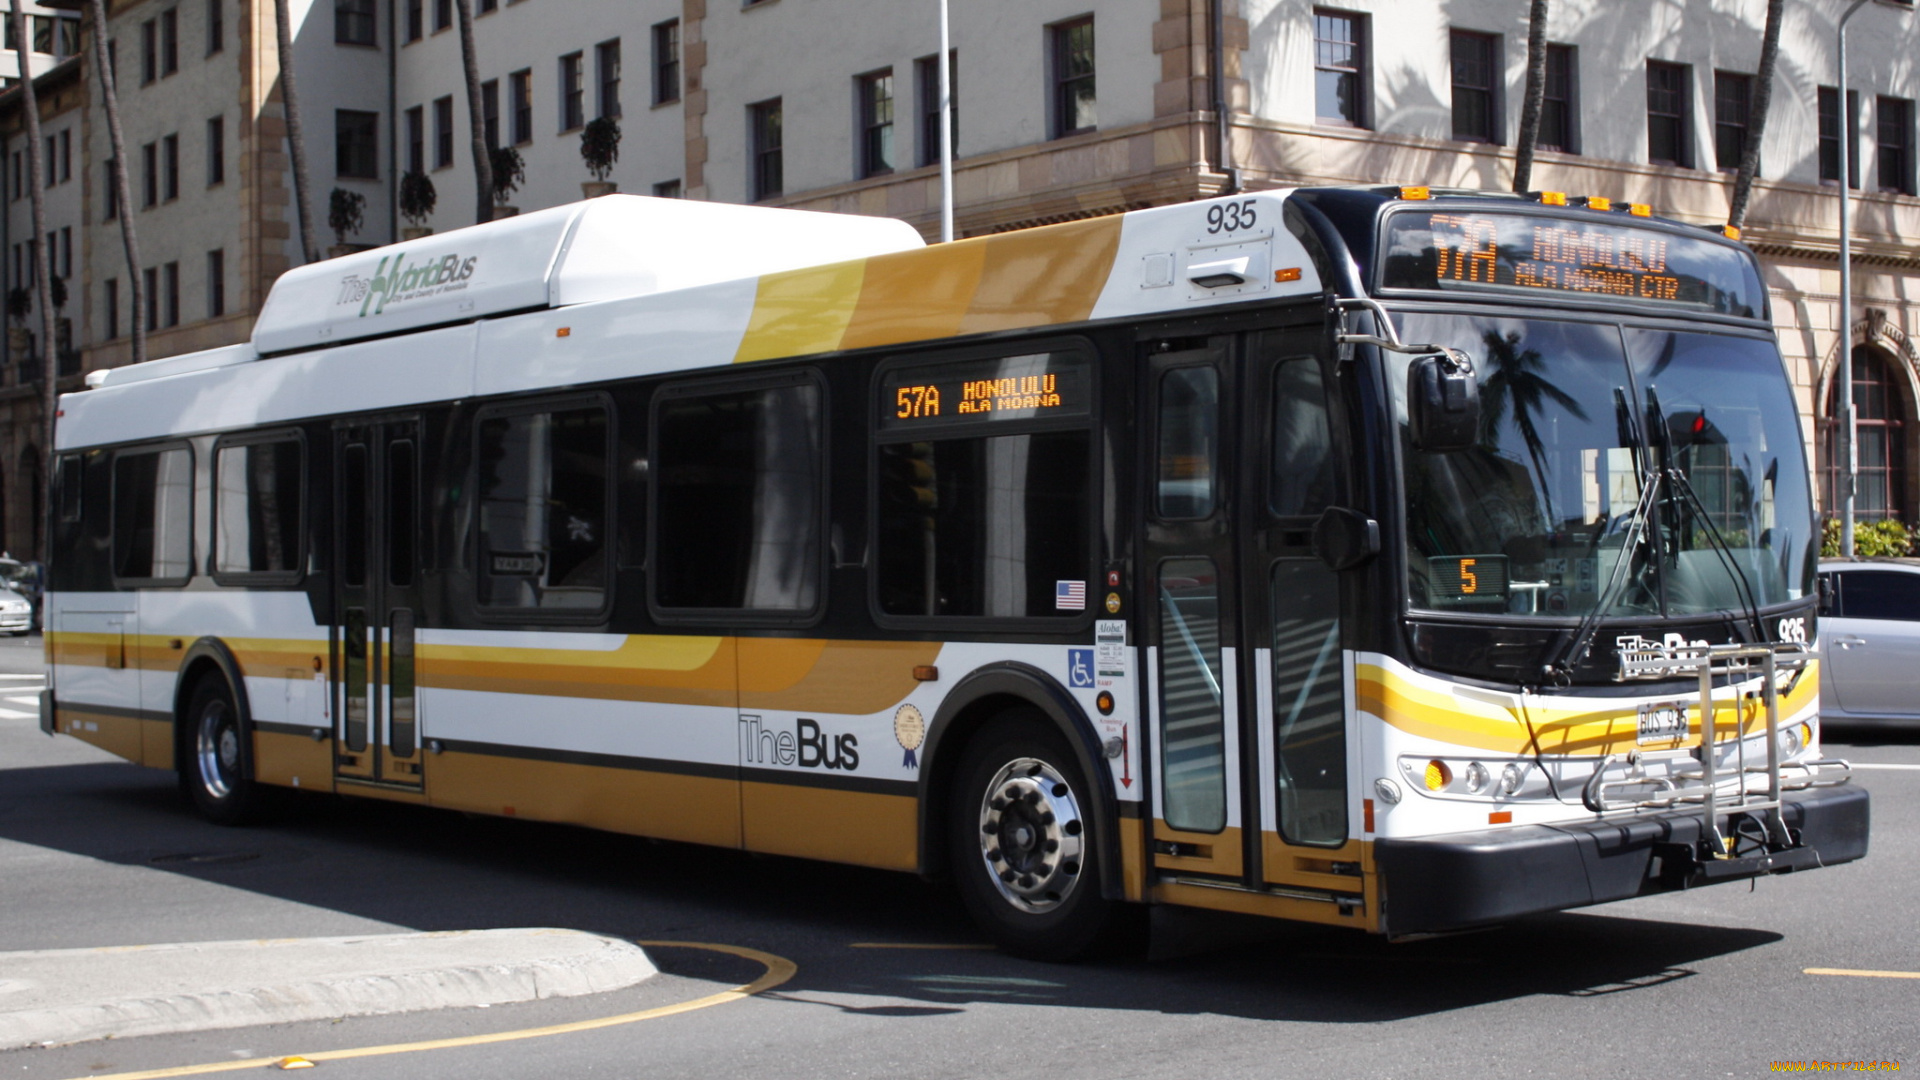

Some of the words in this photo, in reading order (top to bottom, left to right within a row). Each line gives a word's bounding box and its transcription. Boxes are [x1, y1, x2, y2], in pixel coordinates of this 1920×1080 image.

[1207, 199, 1256, 234] 935
[1534, 226, 1666, 273] HONOLULU
[1515, 262, 1558, 288] ALA
[1564, 267, 1634, 296] MOANA
[1640, 275, 1679, 300] CTR
[897, 386, 939, 418] 57A
[963, 374, 1055, 400] HONOLULU
[959, 399, 991, 413] ALA
[998, 394, 1061, 410] MOANA
[1460, 559, 1477, 593] 5
[1778, 618, 1806, 644] 935
[1640, 710, 1660, 734] BUS
[1667, 707, 1687, 731] 935
